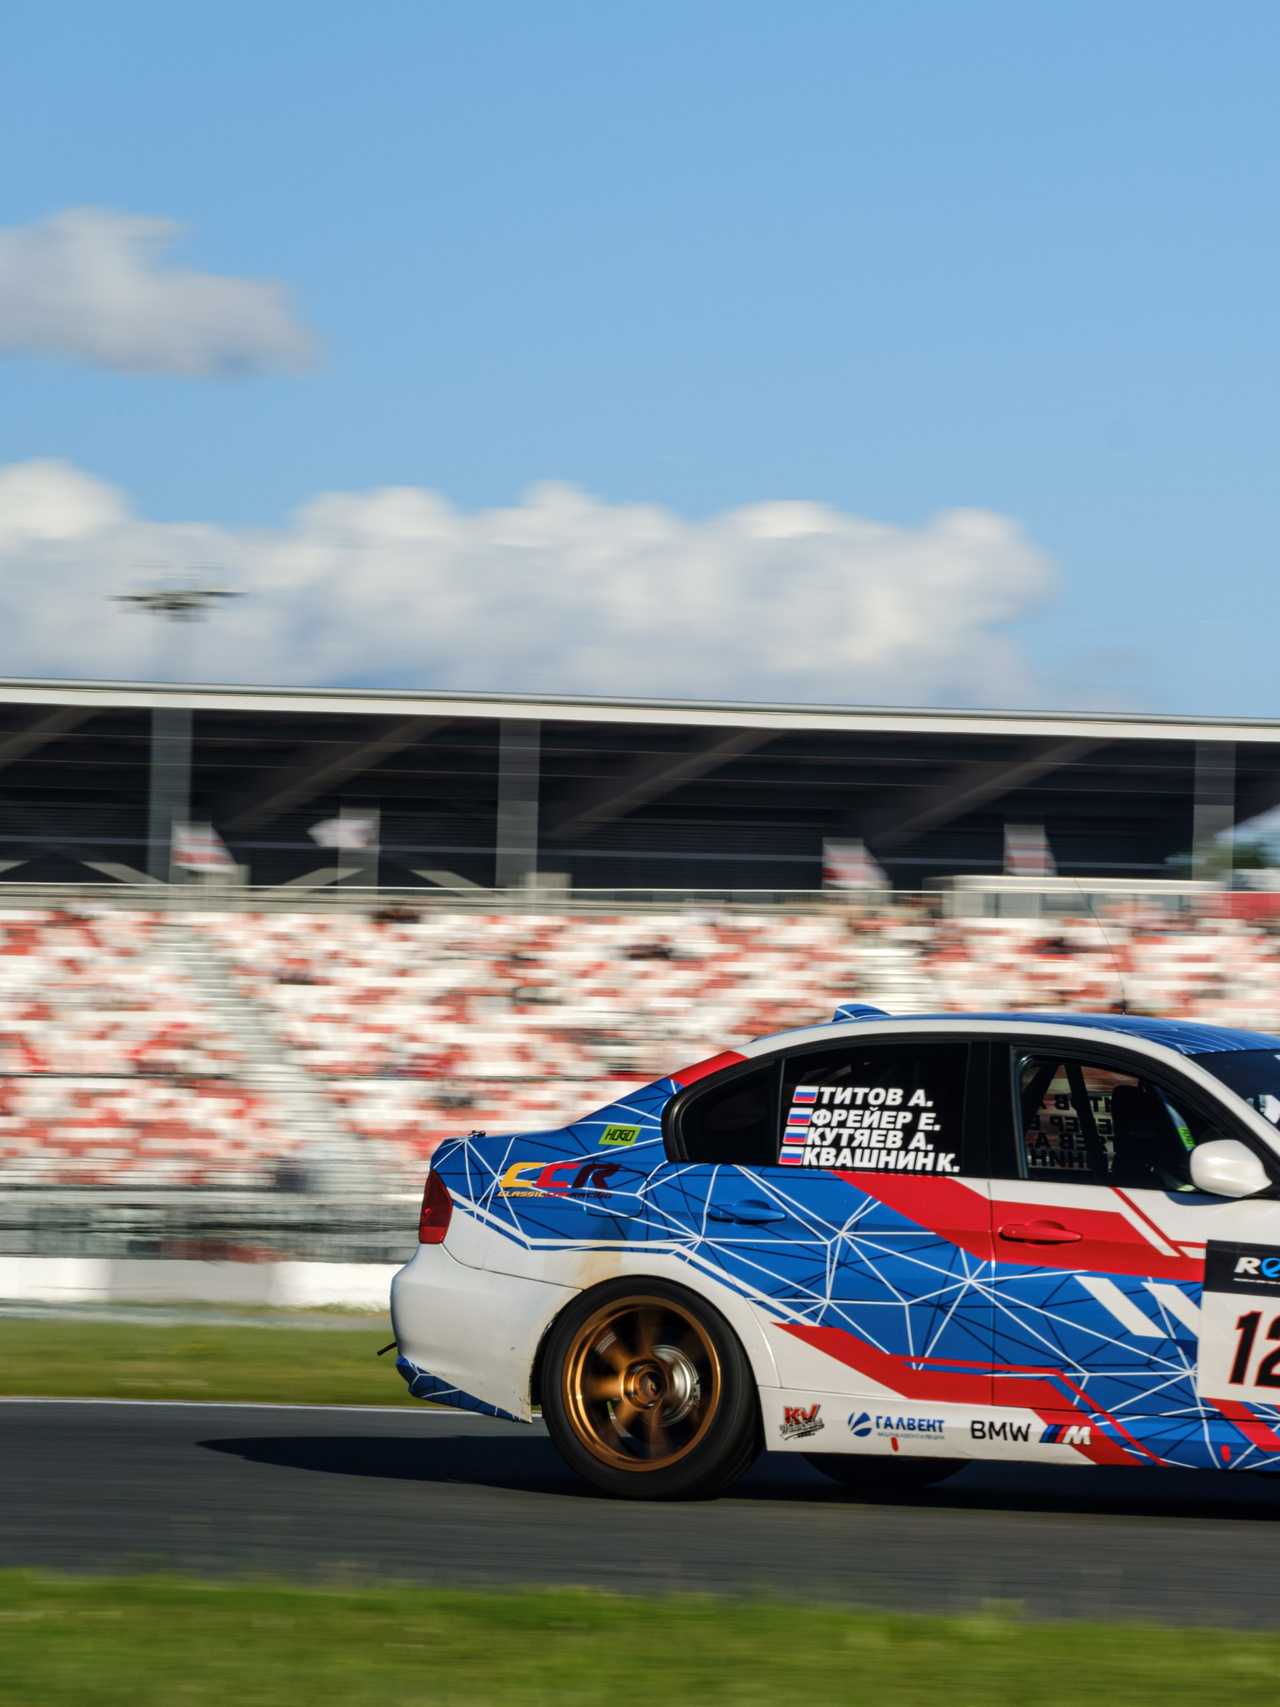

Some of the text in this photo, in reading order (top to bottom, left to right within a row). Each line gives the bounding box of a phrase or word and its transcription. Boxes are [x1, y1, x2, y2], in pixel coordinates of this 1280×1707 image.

[819, 1087, 934, 1107] ТИТОВ А.
[811, 1106, 941, 1131] ФРЕЙЕР Е.
[604, 1128, 636, 1142] HOGO
[805, 1127, 934, 1150] КУТЯЕВ А.
[802, 1147, 960, 1172] КВАШНИН К.
[499, 1162, 622, 1190] CCR
[876, 1415, 945, 1433] ГАЛВЕНТ
[970, 1420, 1031, 1442] BMW
